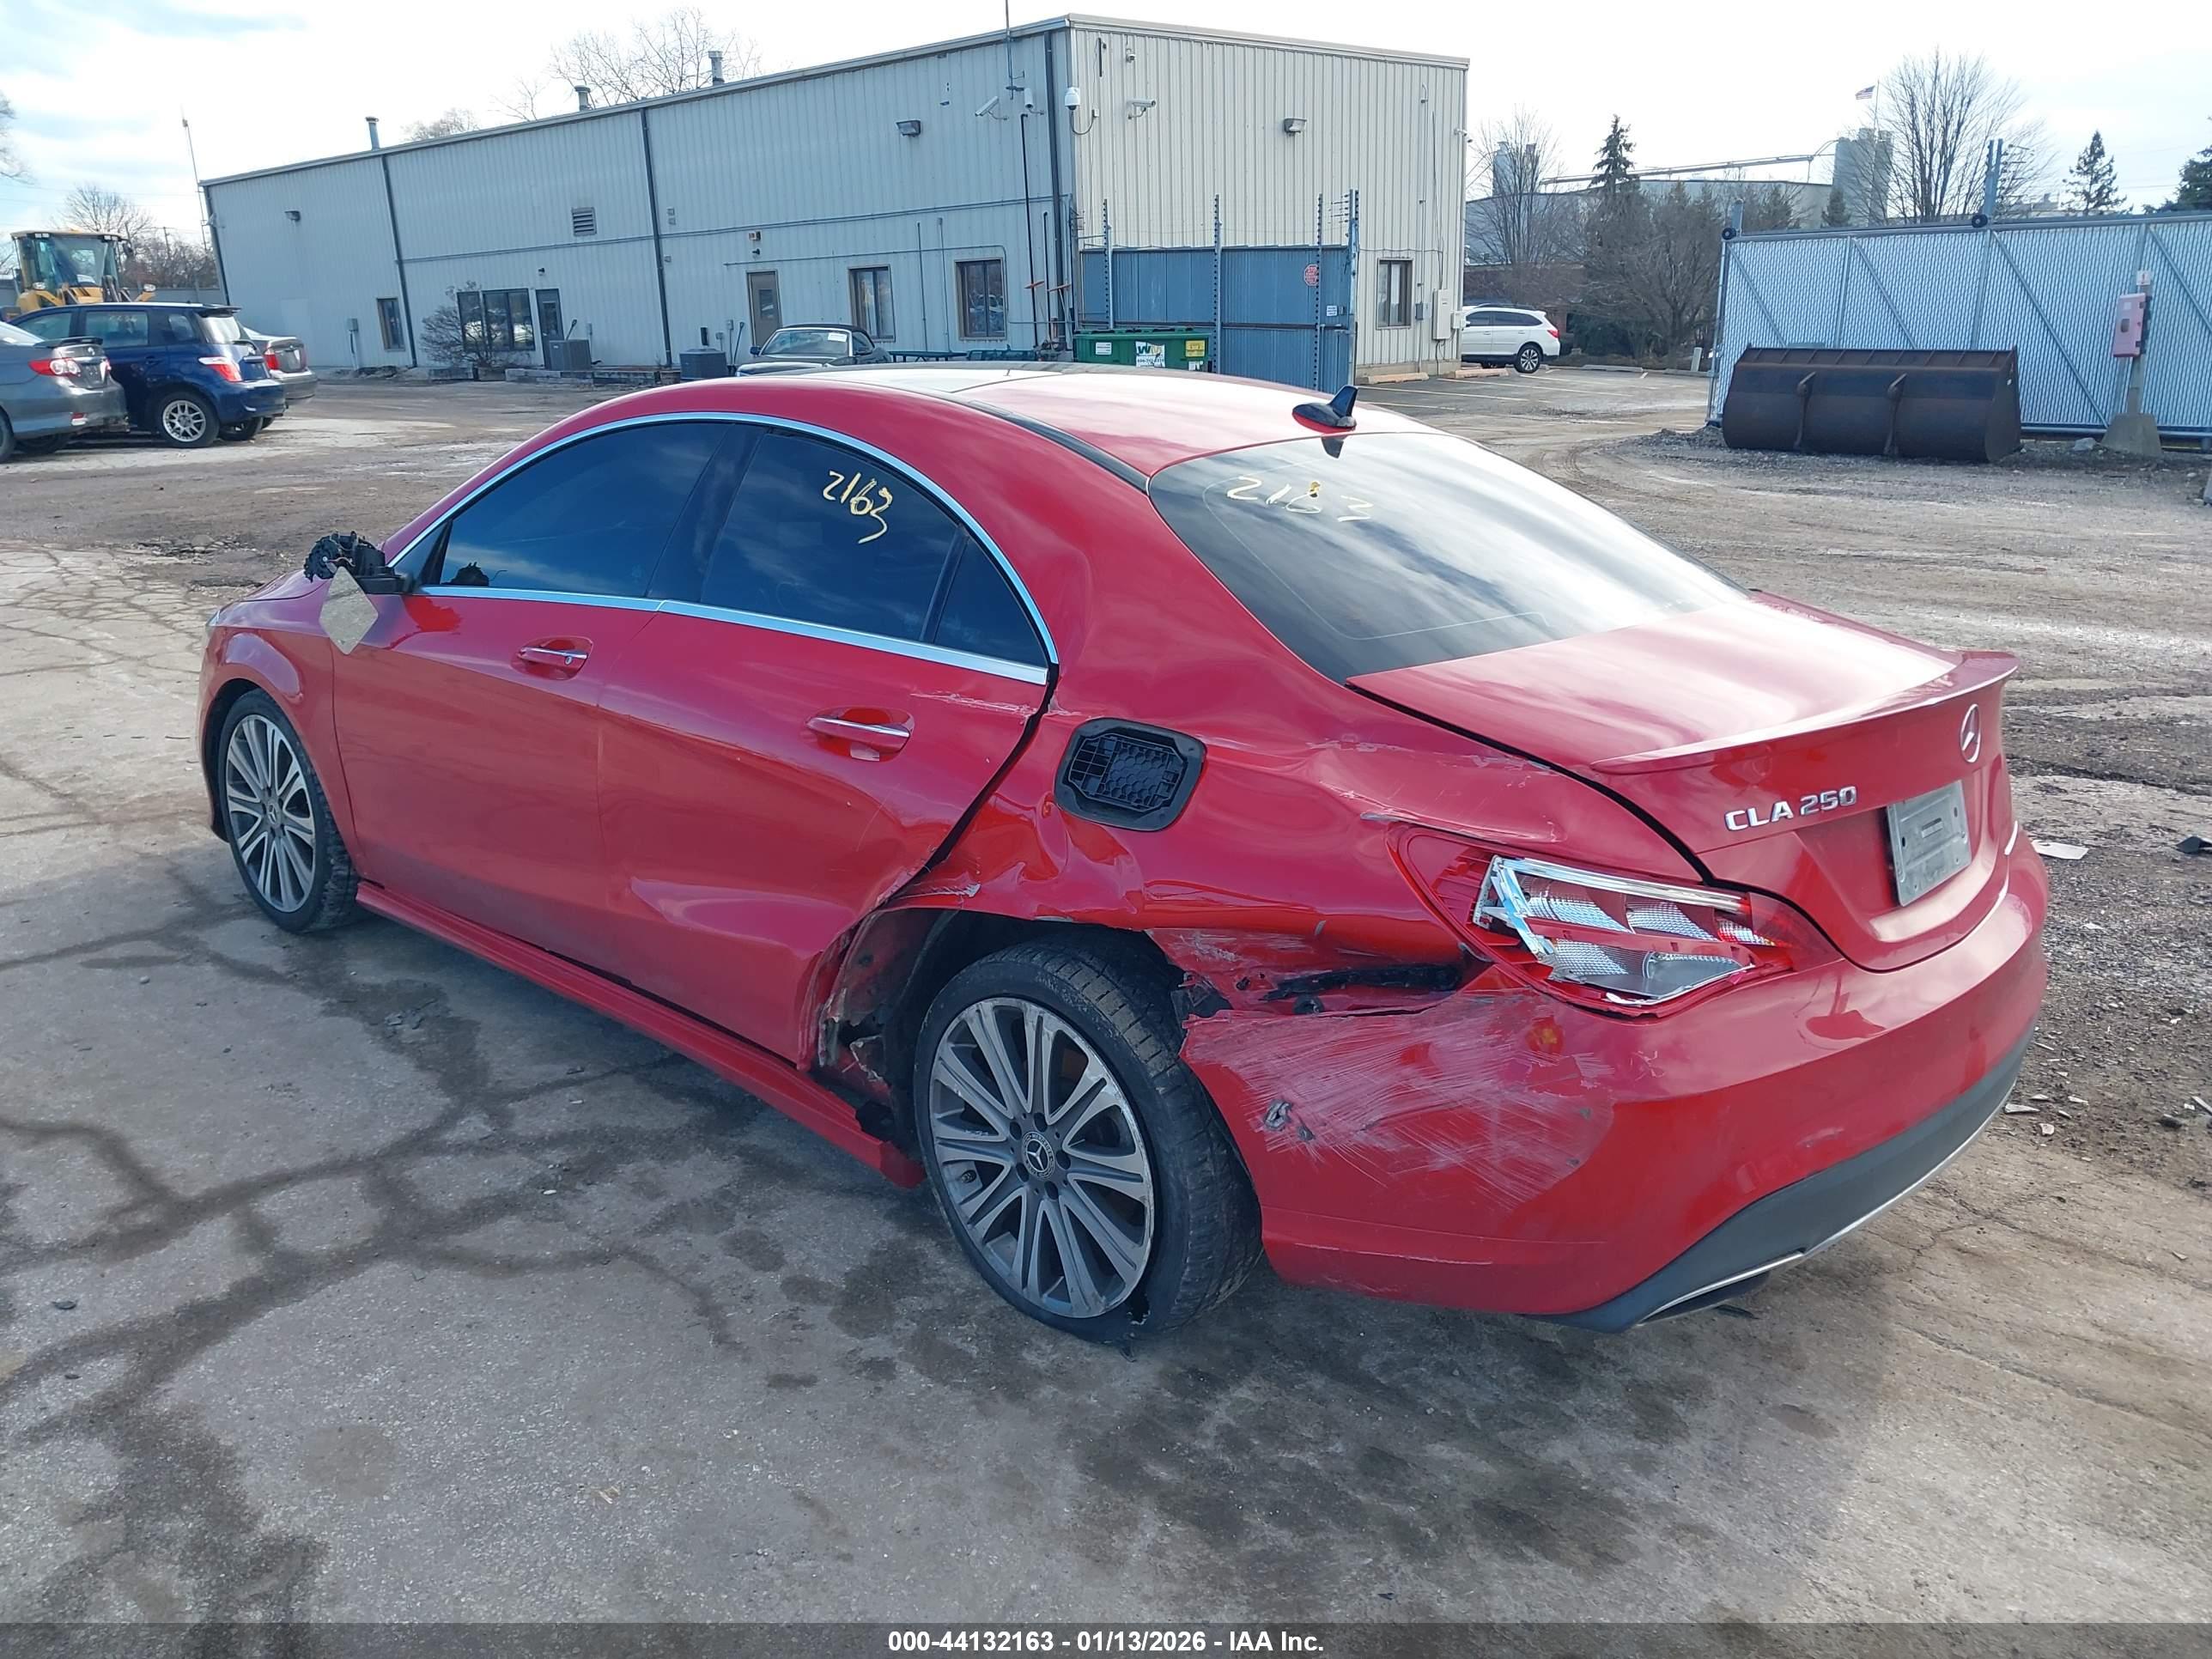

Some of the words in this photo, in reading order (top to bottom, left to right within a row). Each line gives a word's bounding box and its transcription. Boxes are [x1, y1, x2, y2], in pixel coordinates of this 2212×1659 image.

[823, 470, 893, 544] 2163
[1724, 800, 1795, 831] CLA
[1799, 786, 1858, 817] 250
